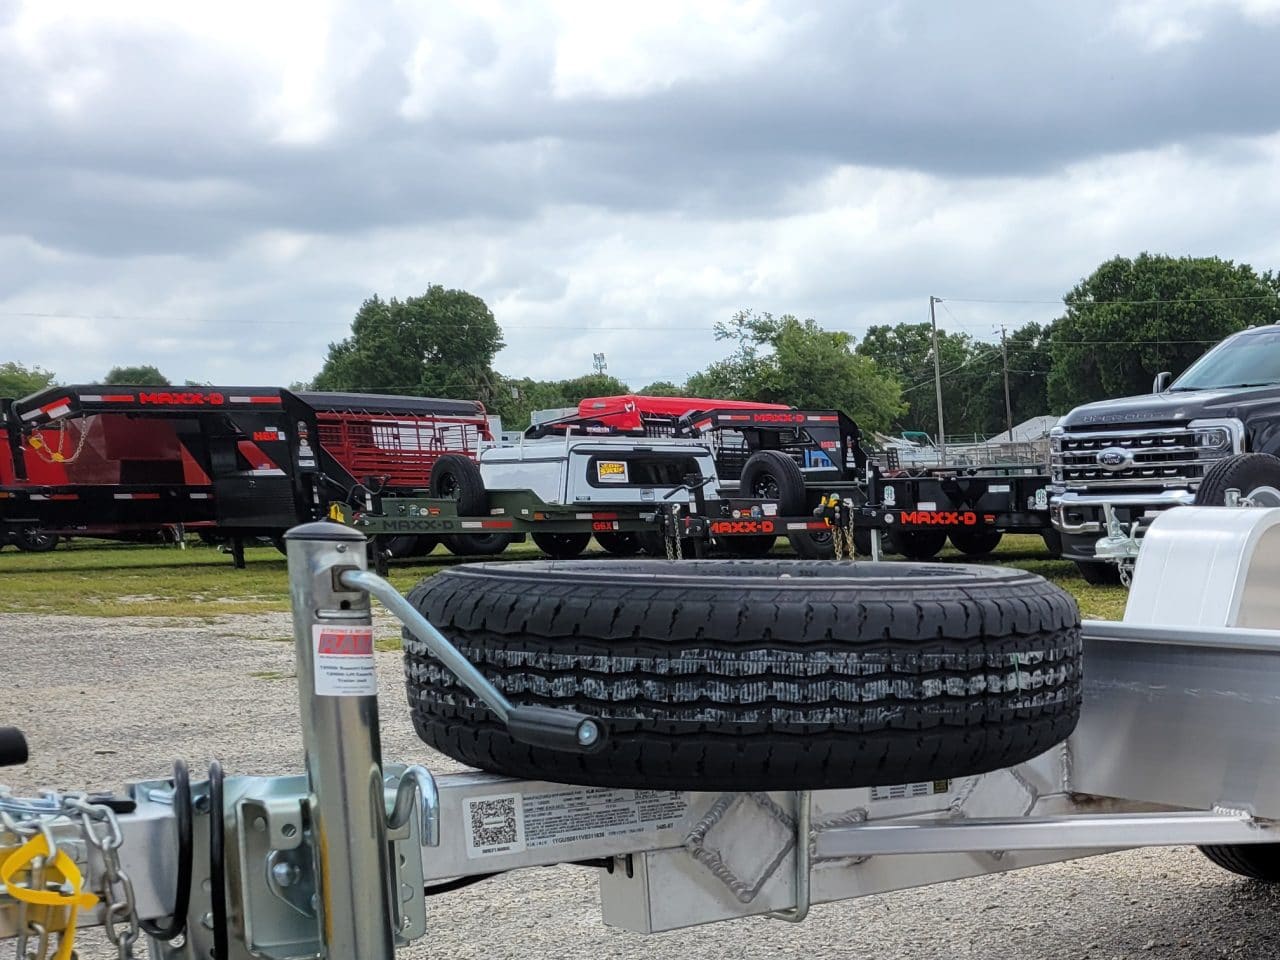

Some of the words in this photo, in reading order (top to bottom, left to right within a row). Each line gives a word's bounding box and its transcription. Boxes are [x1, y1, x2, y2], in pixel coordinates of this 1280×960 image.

[138, 392, 225, 405] MAXX-D
[1103, 453, 1122, 464] Ford
[901, 511, 978, 525] MAXX-D
